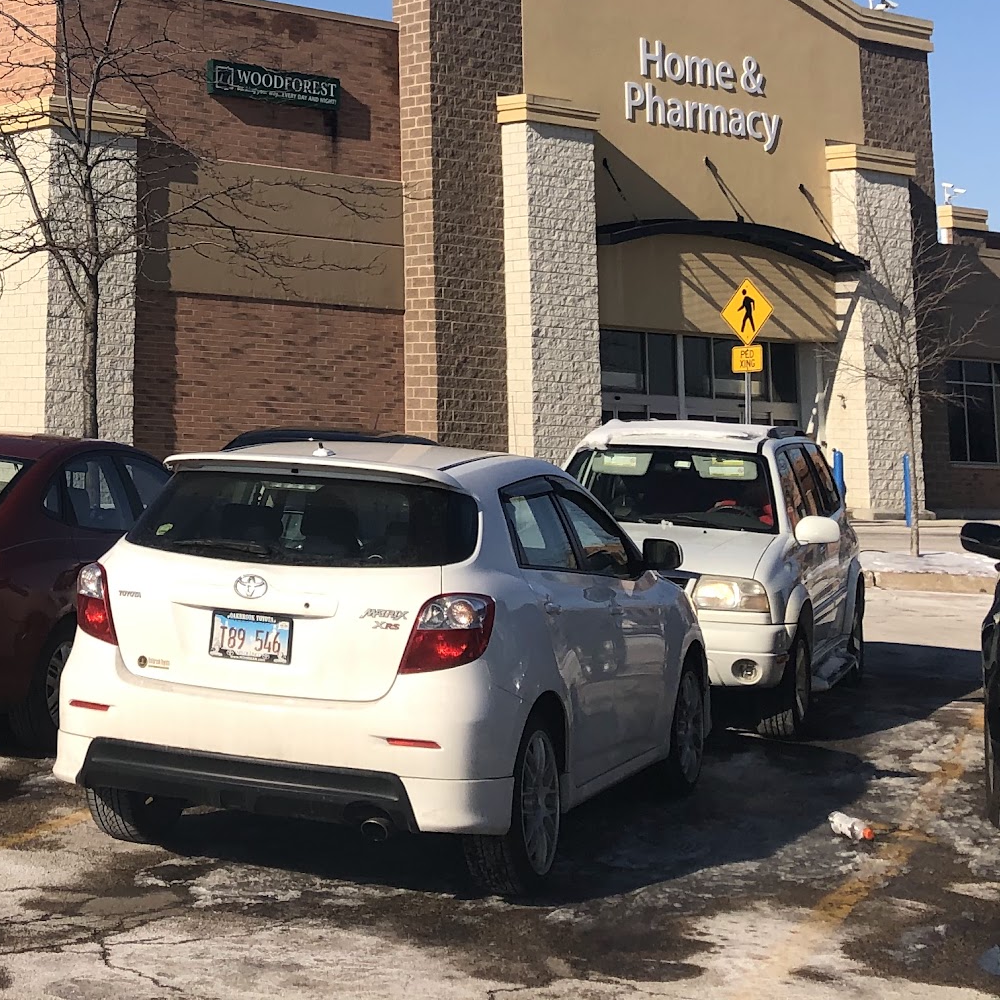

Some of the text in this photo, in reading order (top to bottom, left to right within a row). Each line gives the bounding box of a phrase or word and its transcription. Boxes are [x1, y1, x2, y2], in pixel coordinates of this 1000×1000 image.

[640, 37, 764, 94] Home &
[237, 69, 337, 97] WOODFOREST
[624, 81, 780, 152] Pharmacy
[740, 350, 754, 358] PED
[740, 359, 755, 367] XING
[119, 590, 141, 598] TOYOTA
[372, 621, 400, 630] XRS
[220, 626, 280, 653] T89 546
